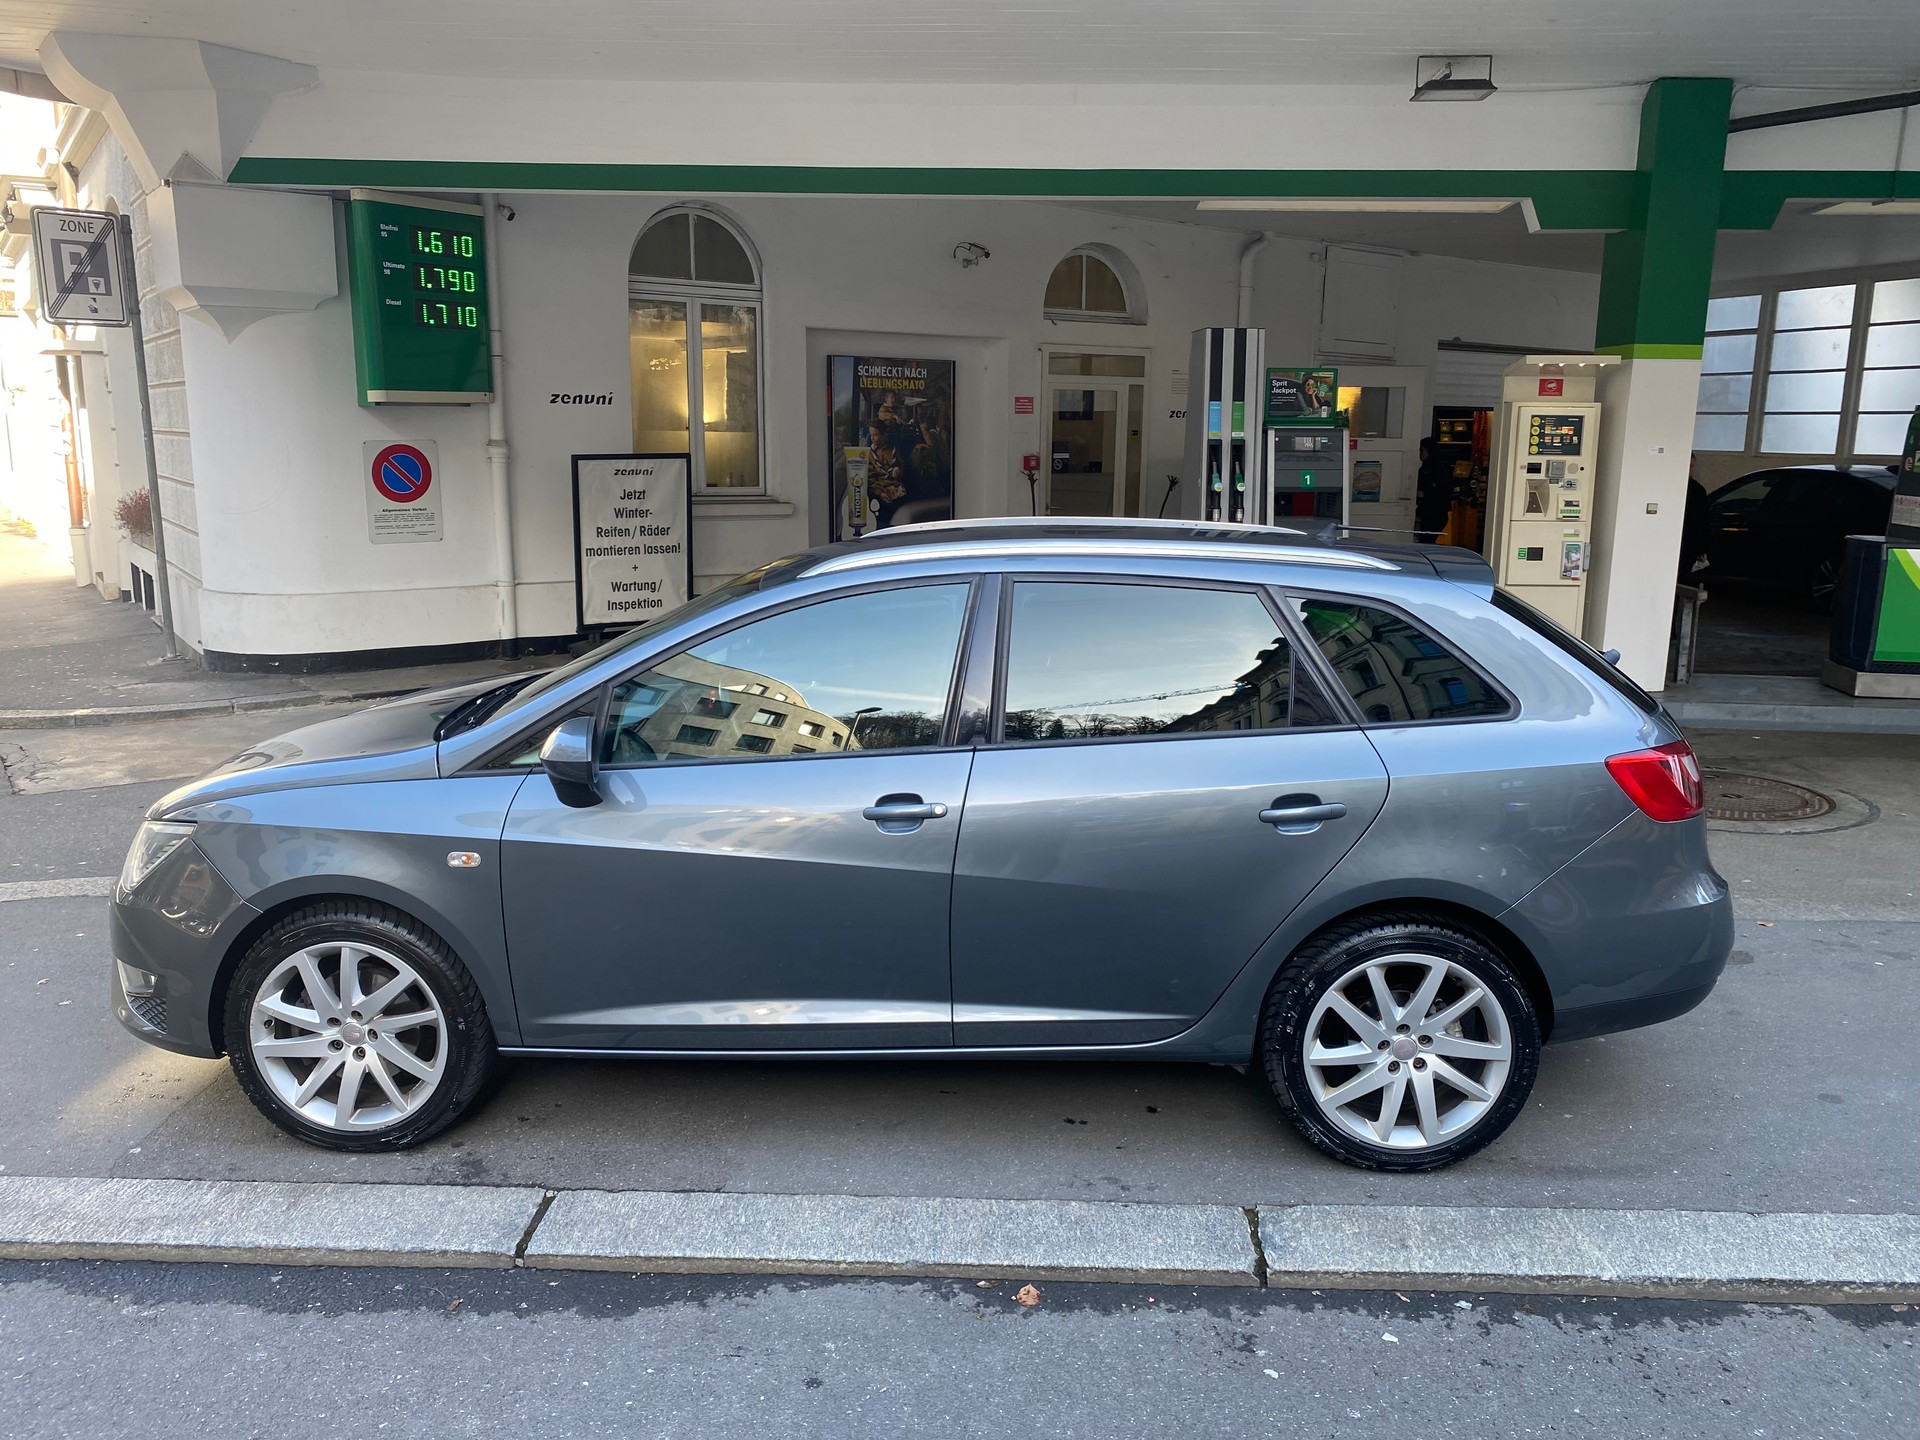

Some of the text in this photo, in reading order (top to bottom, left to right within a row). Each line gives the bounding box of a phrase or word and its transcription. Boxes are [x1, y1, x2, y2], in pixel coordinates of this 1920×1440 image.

[59, 219, 95, 234] ZONE
[380, 223, 399, 232] Bleifrei
[383, 261, 406, 270] Ultimate
[420, 267, 476, 293] 1.790
[385, 298, 402, 306] Diesel
[857, 364, 928, 379] SCHMECKT NACH
[860, 377, 926, 391] LIEBLINGSMAYO
[1271, 379, 1288, 389] Sprit
[1271, 386, 1297, 395] Jackpot
[549, 392, 614, 405] zenuni
[613, 467, 654, 476] zenuni
[1304, 474, 1311, 486] 1
[619, 488, 646, 501] Jetzt
[613, 507, 653, 519] Winter-
[596, 526, 631, 538] Reifen
[639, 524, 671, 537] Räder
[585, 542, 681, 557] montieren lassen!
[607, 597, 663, 612] Inspektion
